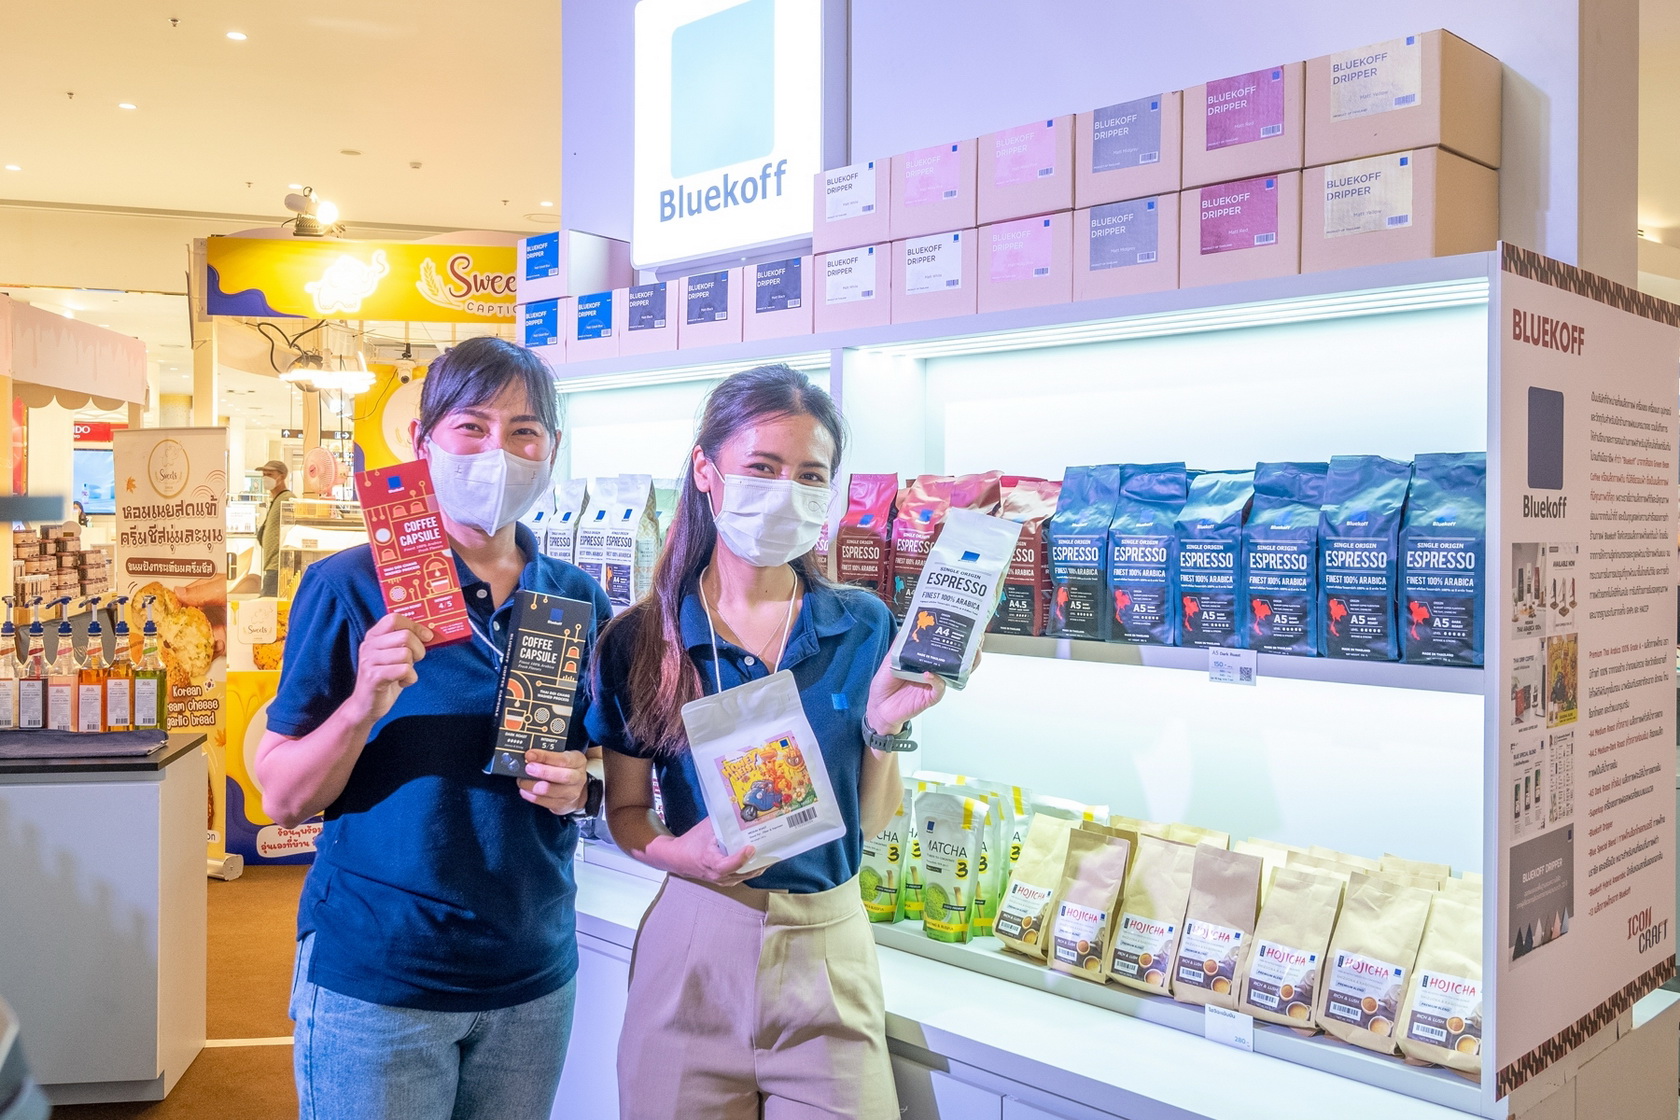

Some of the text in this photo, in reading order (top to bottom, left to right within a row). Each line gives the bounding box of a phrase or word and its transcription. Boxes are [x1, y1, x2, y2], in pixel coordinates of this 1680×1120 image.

[1333, 52, 1388, 72] BLUEKOFF
[1333, 68, 1378, 85] DRIPPER
[1208, 86, 1256, 104] BLUEKOFF
[1208, 100, 1247, 116] DRIPPER
[1094, 114, 1137, 129] BLUEKOFF
[996, 132, 1034, 148] BLUEKOFF
[1094, 127, 1129, 140] DRIPPER
[996, 145, 1028, 158] DRIPPER
[906, 155, 941, 168] BLUEKOFF
[827, 172, 858, 185] BLUEKOFF
[906, 167, 934, 178] DRIPPER
[1326, 172, 1381, 189] BLUEKOFF
[660, 159, 787, 222] Bluekoff
[827, 184, 853, 195] DRIPPER
[1326, 186, 1371, 201] DRIPPER
[1202, 193, 1250, 209] BLUEKOFF
[1202, 206, 1241, 220] DRIPPER
[1092, 214, 1134, 228] BLUEKOFF
[992, 230, 1031, 242] BLUEKOFF
[1091, 226, 1126, 238] DRIPPER
[527, 242, 548, 252] BLUEKOFF
[907, 244, 942, 256] BLUEKOFF
[992, 240, 1024, 251] DRIPPER
[527, 250, 544, 259] DRIPPER
[907, 255, 936, 266] DRIPPER
[827, 257, 858, 268] BLUEKOFF
[449, 256, 517, 298] Swee
[757, 268, 786, 279] BLUEKOFF
[827, 267, 853, 277] DRIPPER
[688, 282, 714, 292] BLUEKOFF
[757, 278, 781, 287] DRIPPER
[630, 291, 654, 300] BLUEKOFF
[688, 291, 709, 300] DRIPPER
[578, 301, 601, 310] BLUEKOFF
[630, 299, 649, 308] DRIPPER
[526, 310, 546, 320] BLUEKOFF
[578, 310, 596, 318] DRIPPER
[526, 318, 543, 327] DRIPPER
[1513, 308, 1584, 356] BLUEKOFF
[122, 496, 218, 520] หอมเนยสดแท้
[1523, 495, 1567, 518] Bluekoff
[404, 517, 438, 533] COFFEE
[120, 521, 223, 551] ครีมชีสนุ่มละมุน
[400, 528, 441, 547] CAPSULE
[842, 546, 880, 559] ESPRESSO
[1053, 547, 1098, 561] ESPRESSO
[1114, 546, 1166, 563] ESPRESSO
[1180, 552, 1233, 567] ESPRESSO
[1326, 551, 1387, 568] ESPRESSO
[1250, 553, 1307, 570] ESPRESSO
[1407, 551, 1475, 569] ESPRESSO
[940, 566, 981, 580] SINGLE ORIGIN
[1114, 568, 1128, 576] FINEST
[1143, 569, 1165, 577] ARABICA
[1195, 575, 1208, 583] 100%
[1210, 575, 1233, 583] ARABICA
[927, 573, 988, 597] ESPRESSO
[1250, 576, 1306, 586] FINEST 100% ARABICA
[1326, 575, 1386, 585] FINEST 100% ARABICA
[1407, 576, 1474, 586] FINEST 100% ARABICA
[922, 592, 980, 611] FINEST 100% ARABICA
[1009, 600, 1027, 609] A4.5
[1133, 604, 1146, 612] A5
[1202, 612, 1215, 620] A5
[1274, 614, 1287, 624] A5
[1350, 615, 1365, 624] A5
[1433, 618, 1450, 628] A5
[935, 626, 950, 636] A4
[522, 636, 553, 650] COFFEE
[520, 648, 557, 664] CAPSULE
[172, 686, 202, 696] Korean
[188, 698, 219, 711] cheese
[167, 713, 215, 728] garlic bread
[887, 846, 900, 862] 3
[956, 862, 968, 878] 3
[1522, 858, 1563, 883] BLUEKOFF DRIPPER
[1018, 886, 1045, 900] HOJICHA
[1066, 907, 1098, 923] HOJICHA
[1130, 918, 1165, 937] HOJICHA
[1627, 906, 1652, 940] ICON
[1639, 918, 1668, 954] CRAFT
[1267, 948, 1306, 965] HOJICHA
[1345, 958, 1389, 978] HOJICHA
[1430, 977, 1476, 996] HOJICHA
